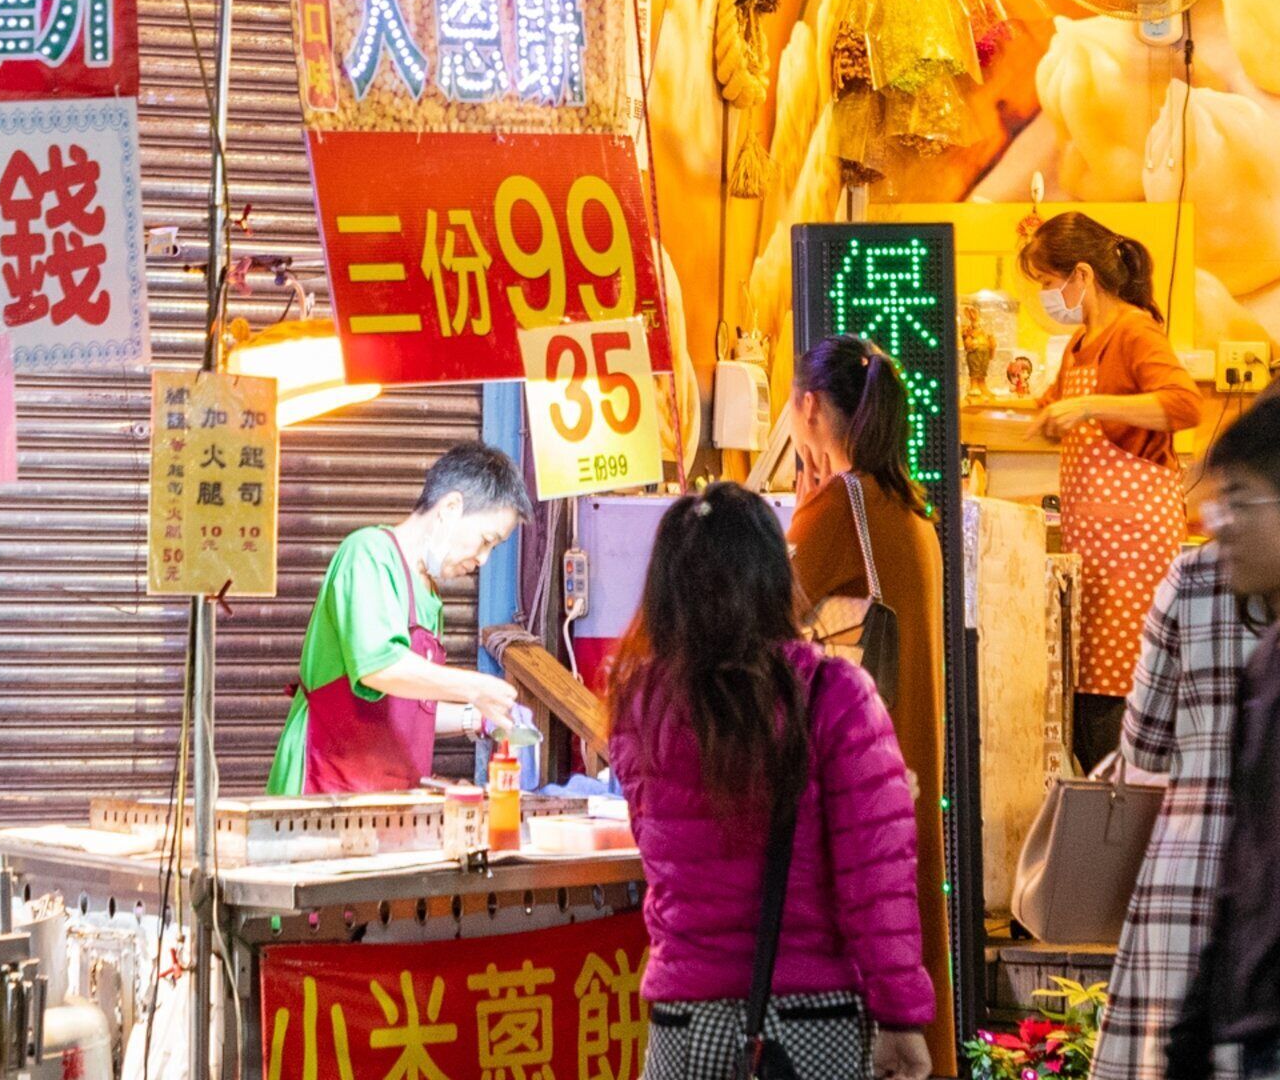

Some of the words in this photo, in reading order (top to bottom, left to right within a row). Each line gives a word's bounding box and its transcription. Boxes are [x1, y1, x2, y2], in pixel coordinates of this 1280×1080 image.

[545, 331, 642, 443] 35
[196, 407, 228, 507] 加火腿
[238, 408, 267, 507] 加起司
[577, 454, 628, 482] 三份99
